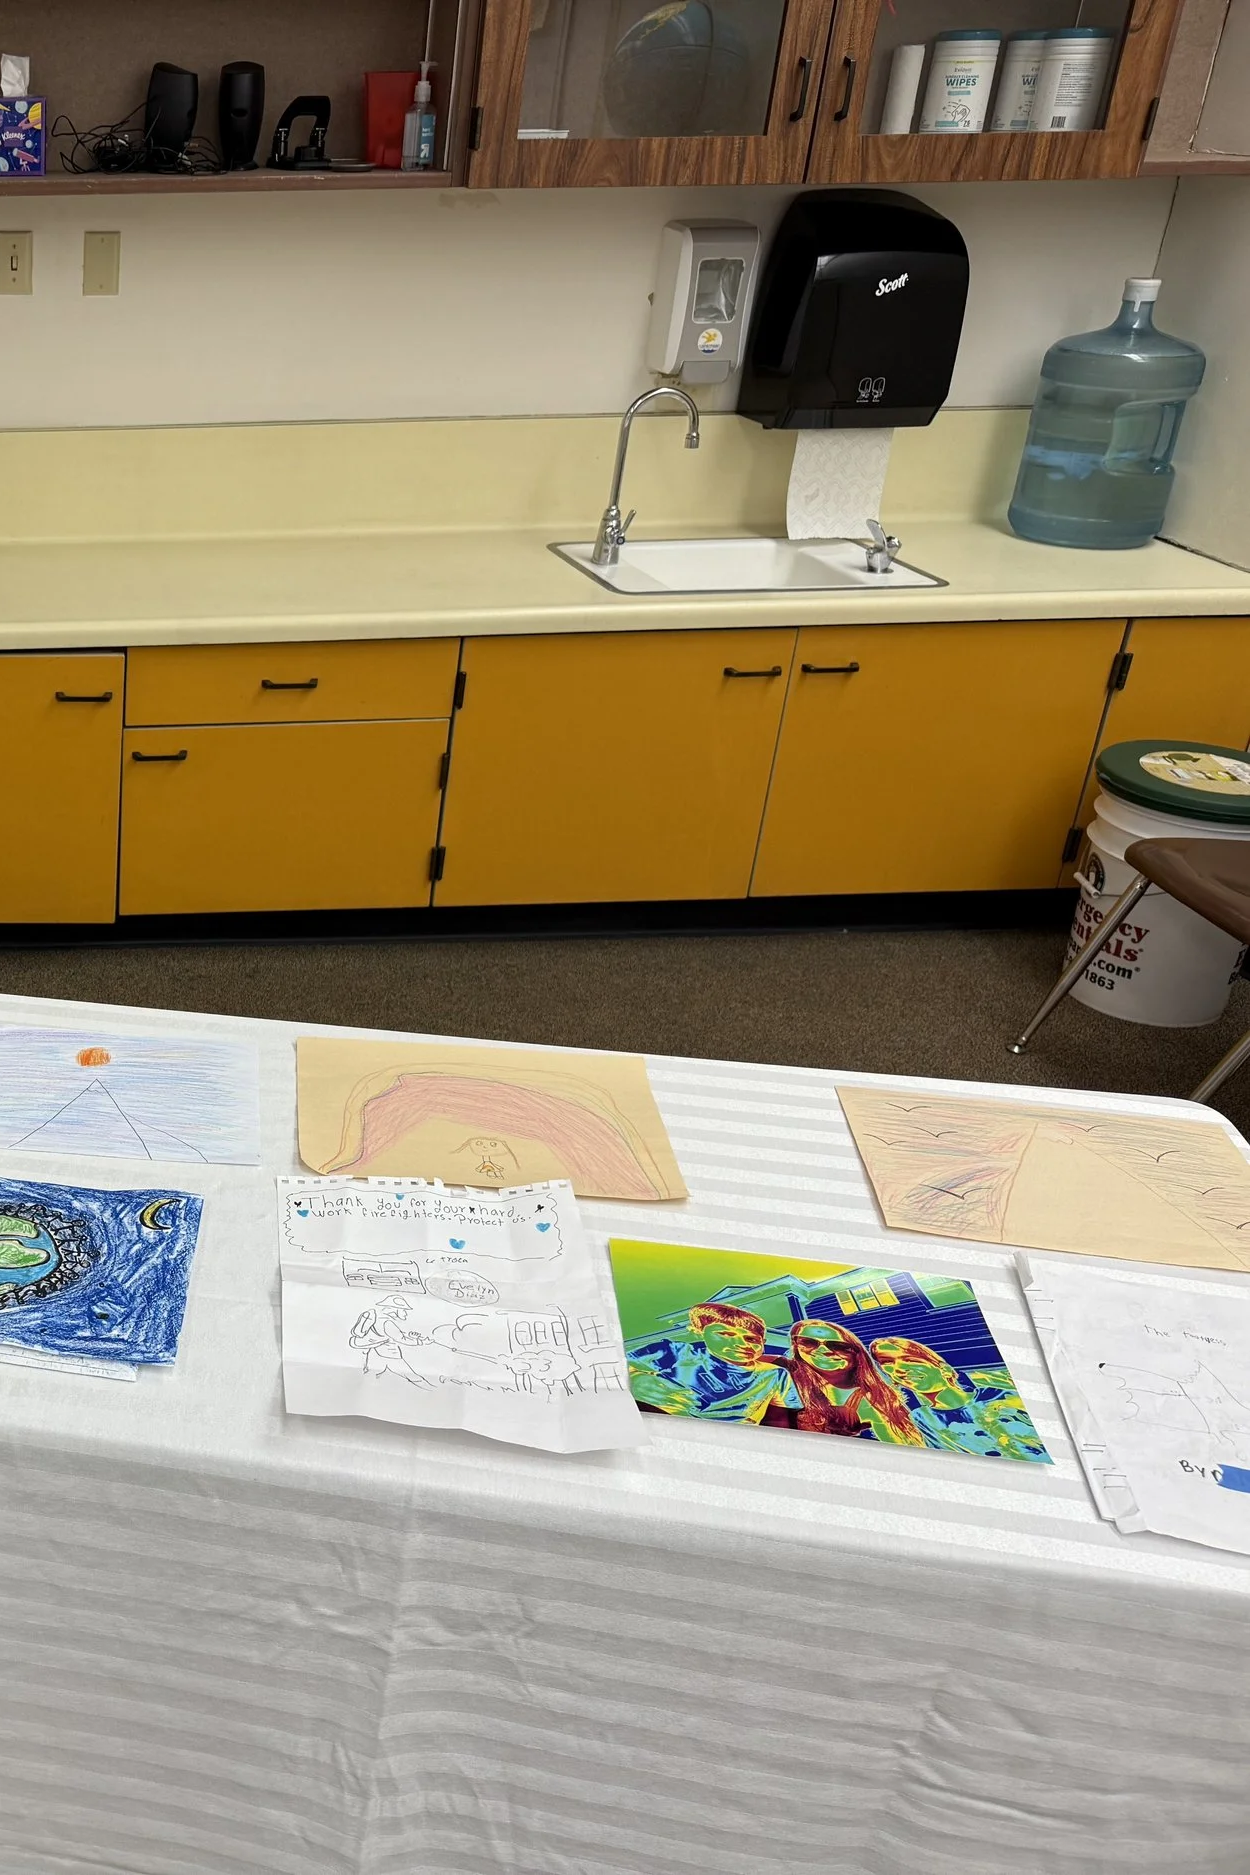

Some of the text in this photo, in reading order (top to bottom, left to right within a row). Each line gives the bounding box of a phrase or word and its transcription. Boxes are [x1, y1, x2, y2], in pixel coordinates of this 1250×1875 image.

[946, 78, 977, 87] WIPES
[875, 272, 908, 296] Scott
[301, 1195, 515, 1218] Thank you for your hard
